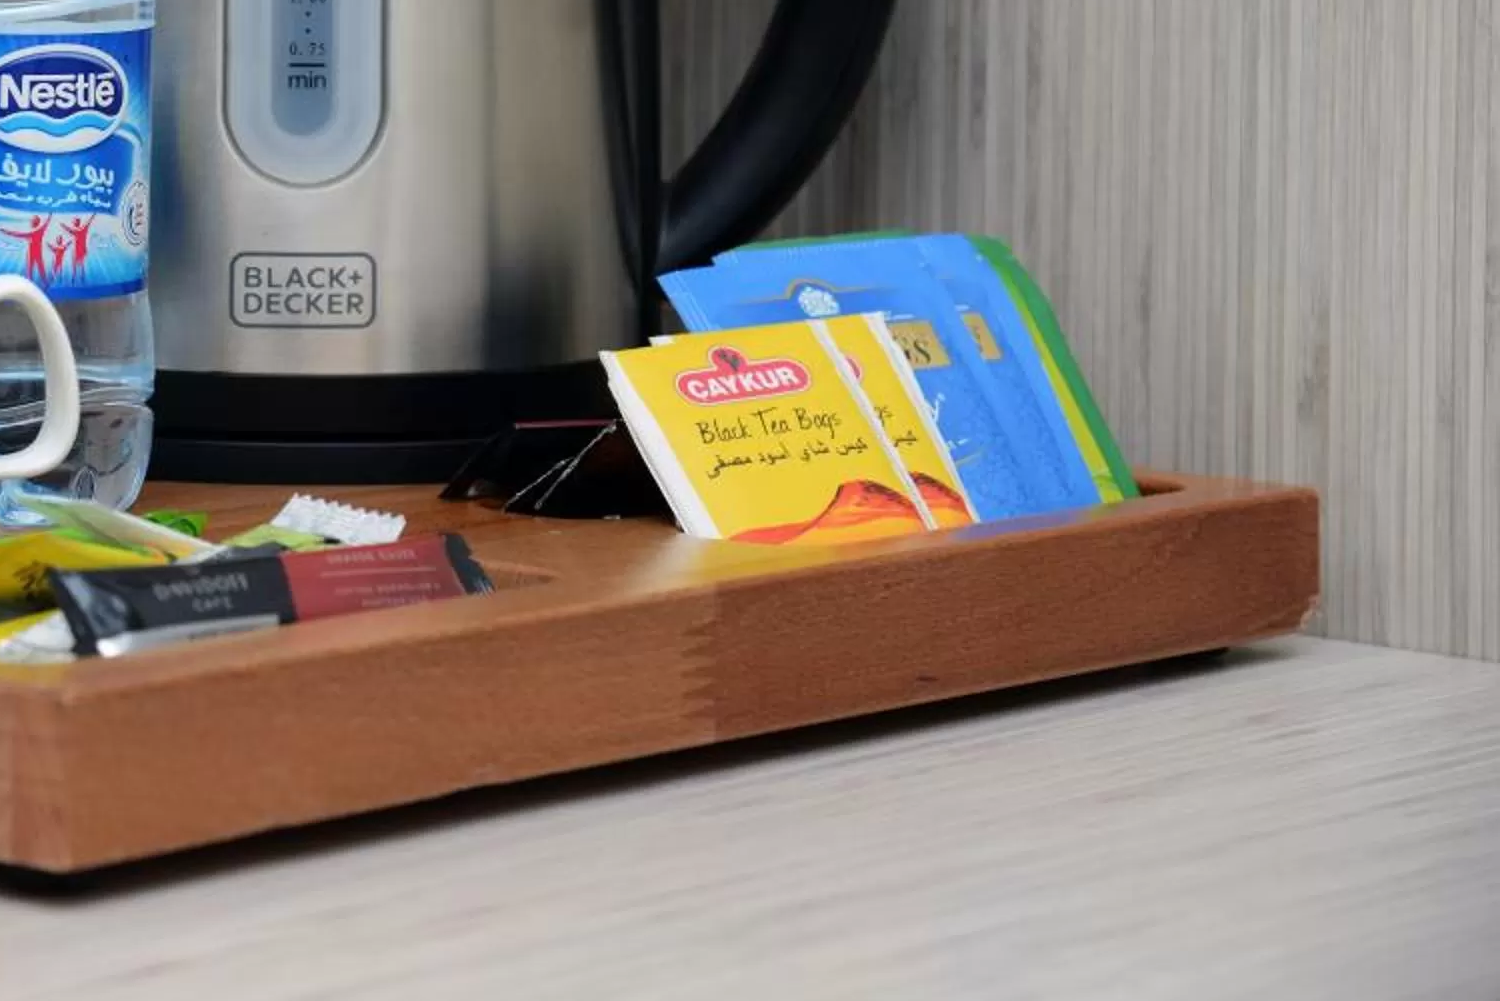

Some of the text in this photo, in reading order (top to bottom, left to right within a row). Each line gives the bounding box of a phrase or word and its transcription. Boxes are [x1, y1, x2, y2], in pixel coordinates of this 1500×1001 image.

[0, 72, 116, 110] Nestlé
[287, 71, 327, 89] min
[243, 266, 364, 289] BLACK+
[243, 292, 365, 315] DECKER
[694, 406, 843, 445] Black Tea Bags
